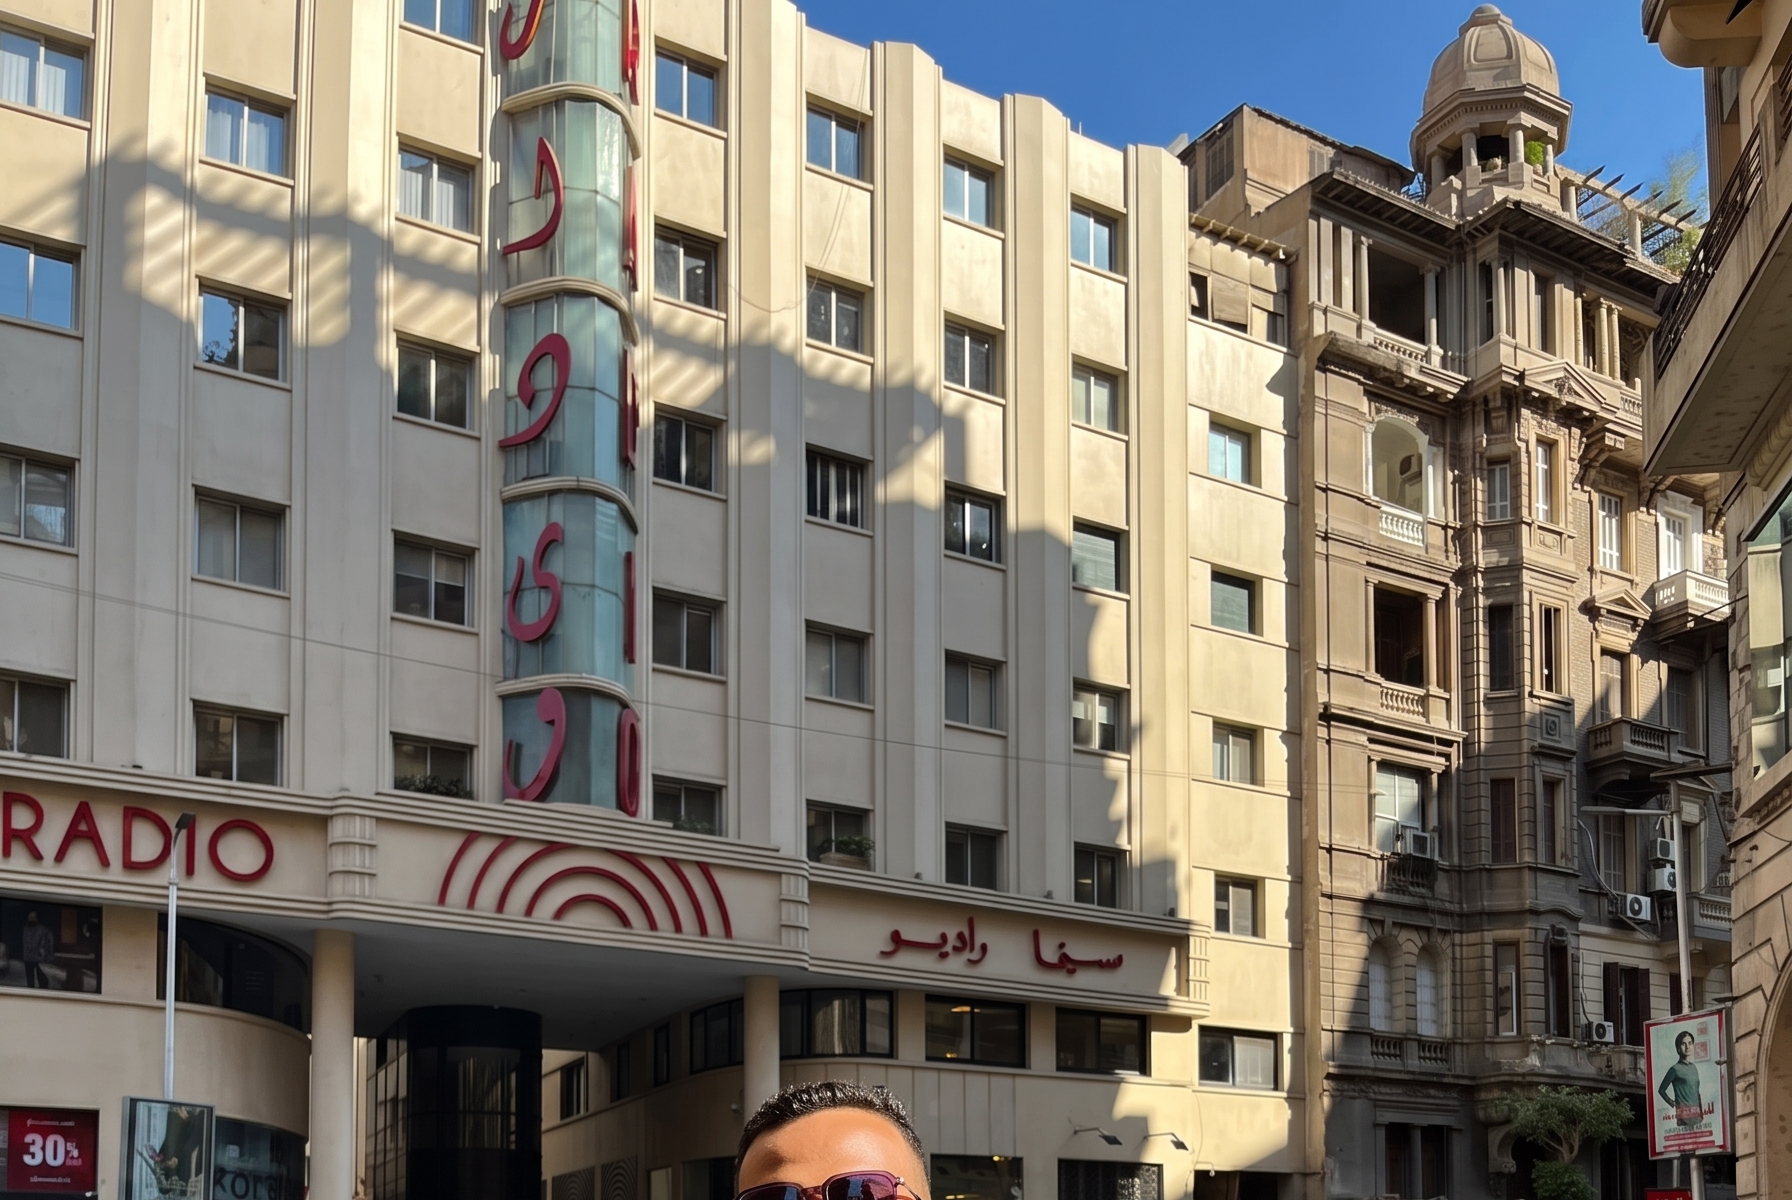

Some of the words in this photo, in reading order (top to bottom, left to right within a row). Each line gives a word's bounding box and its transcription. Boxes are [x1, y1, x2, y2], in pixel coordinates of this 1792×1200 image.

[2, 790, 275, 882] RADIO
[879, 915, 988, 965] راديو
[1032, 928, 1123, 975] سينما
